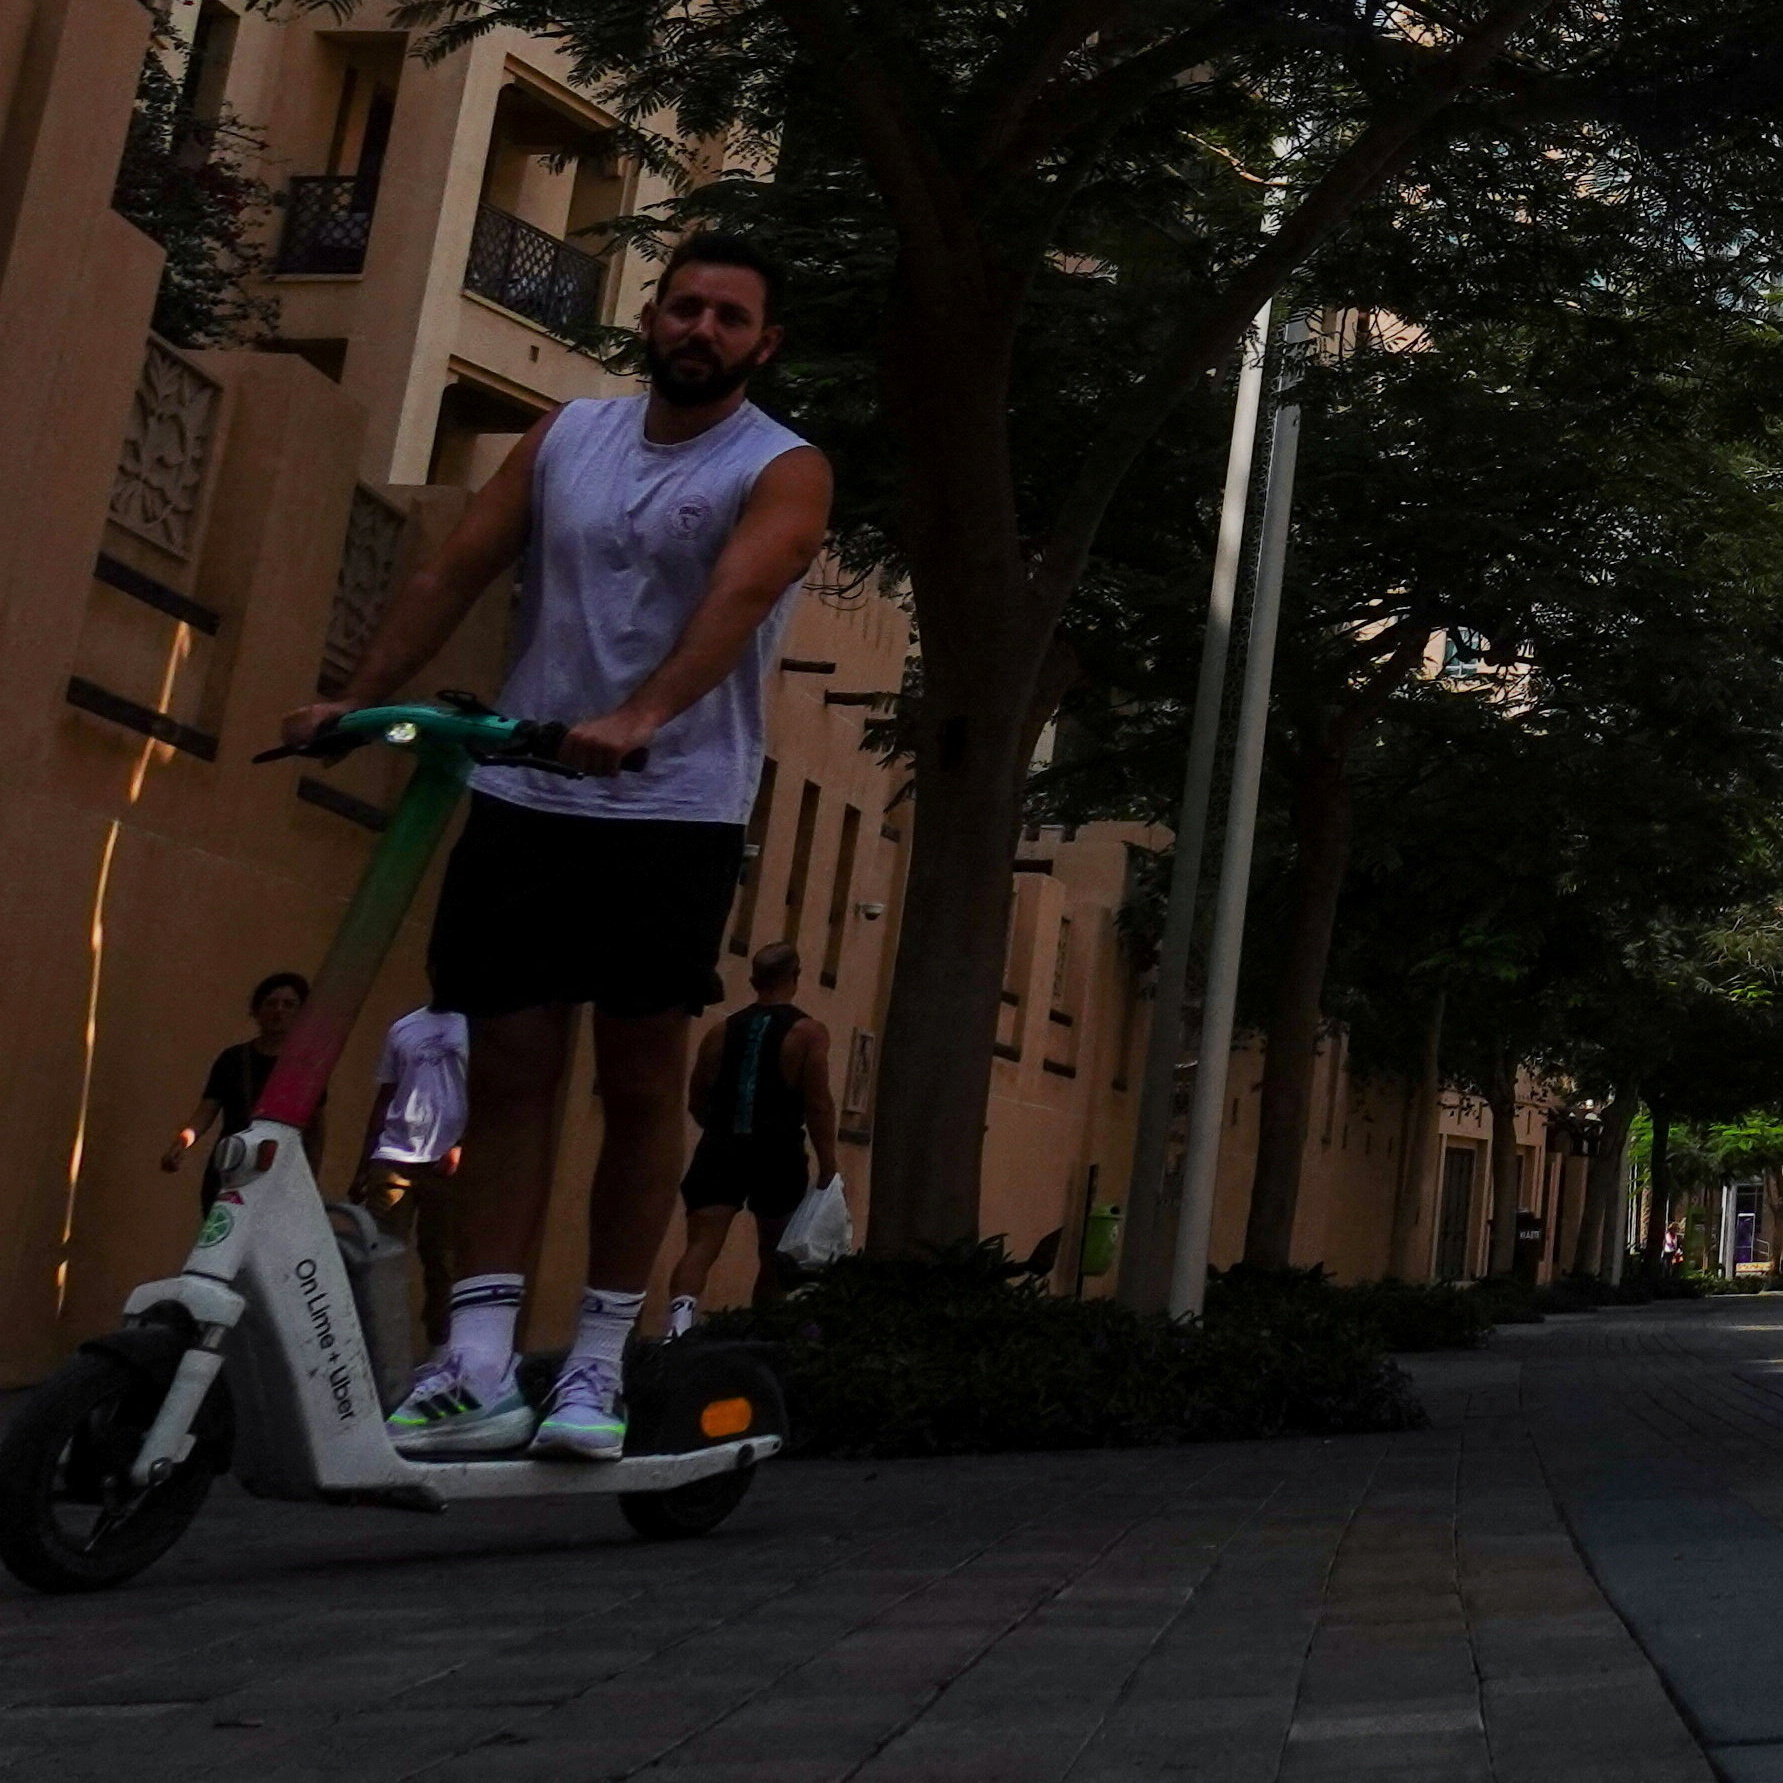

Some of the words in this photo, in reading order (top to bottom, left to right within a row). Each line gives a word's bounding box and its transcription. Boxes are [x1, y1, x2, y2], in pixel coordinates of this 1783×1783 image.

[296, 1259, 318, 1295] On
[307, 1292, 335, 1349] Lime
[329, 1365, 355, 1421] Uber
